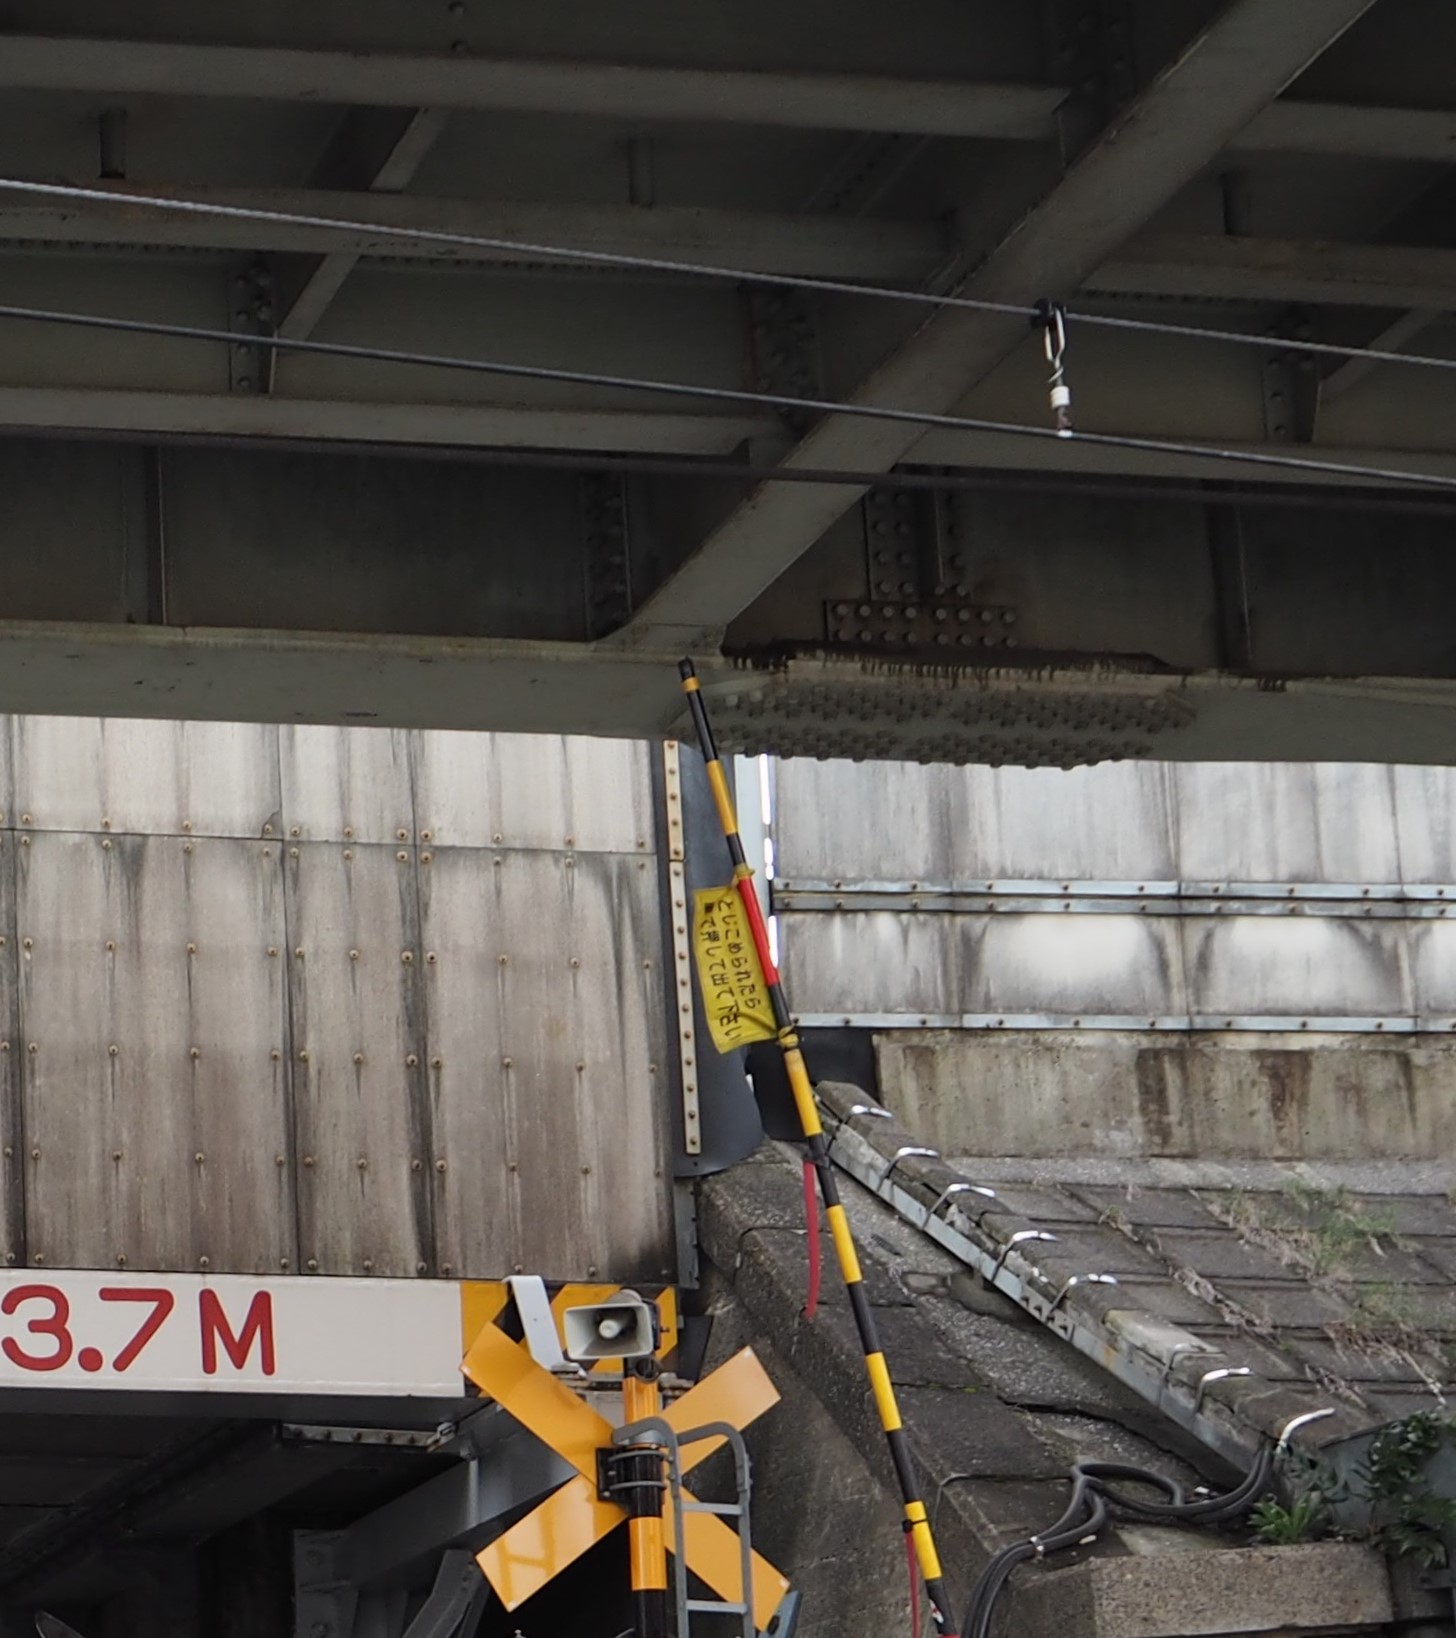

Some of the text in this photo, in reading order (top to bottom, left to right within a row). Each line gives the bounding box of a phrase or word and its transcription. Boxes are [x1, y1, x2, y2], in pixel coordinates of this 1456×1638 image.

[700, 901, 743, 1041] で押して出て下さい
[718, 899, 761, 1010] とじこめられたら
[0, 1285, 277, 1377] 3.7M
